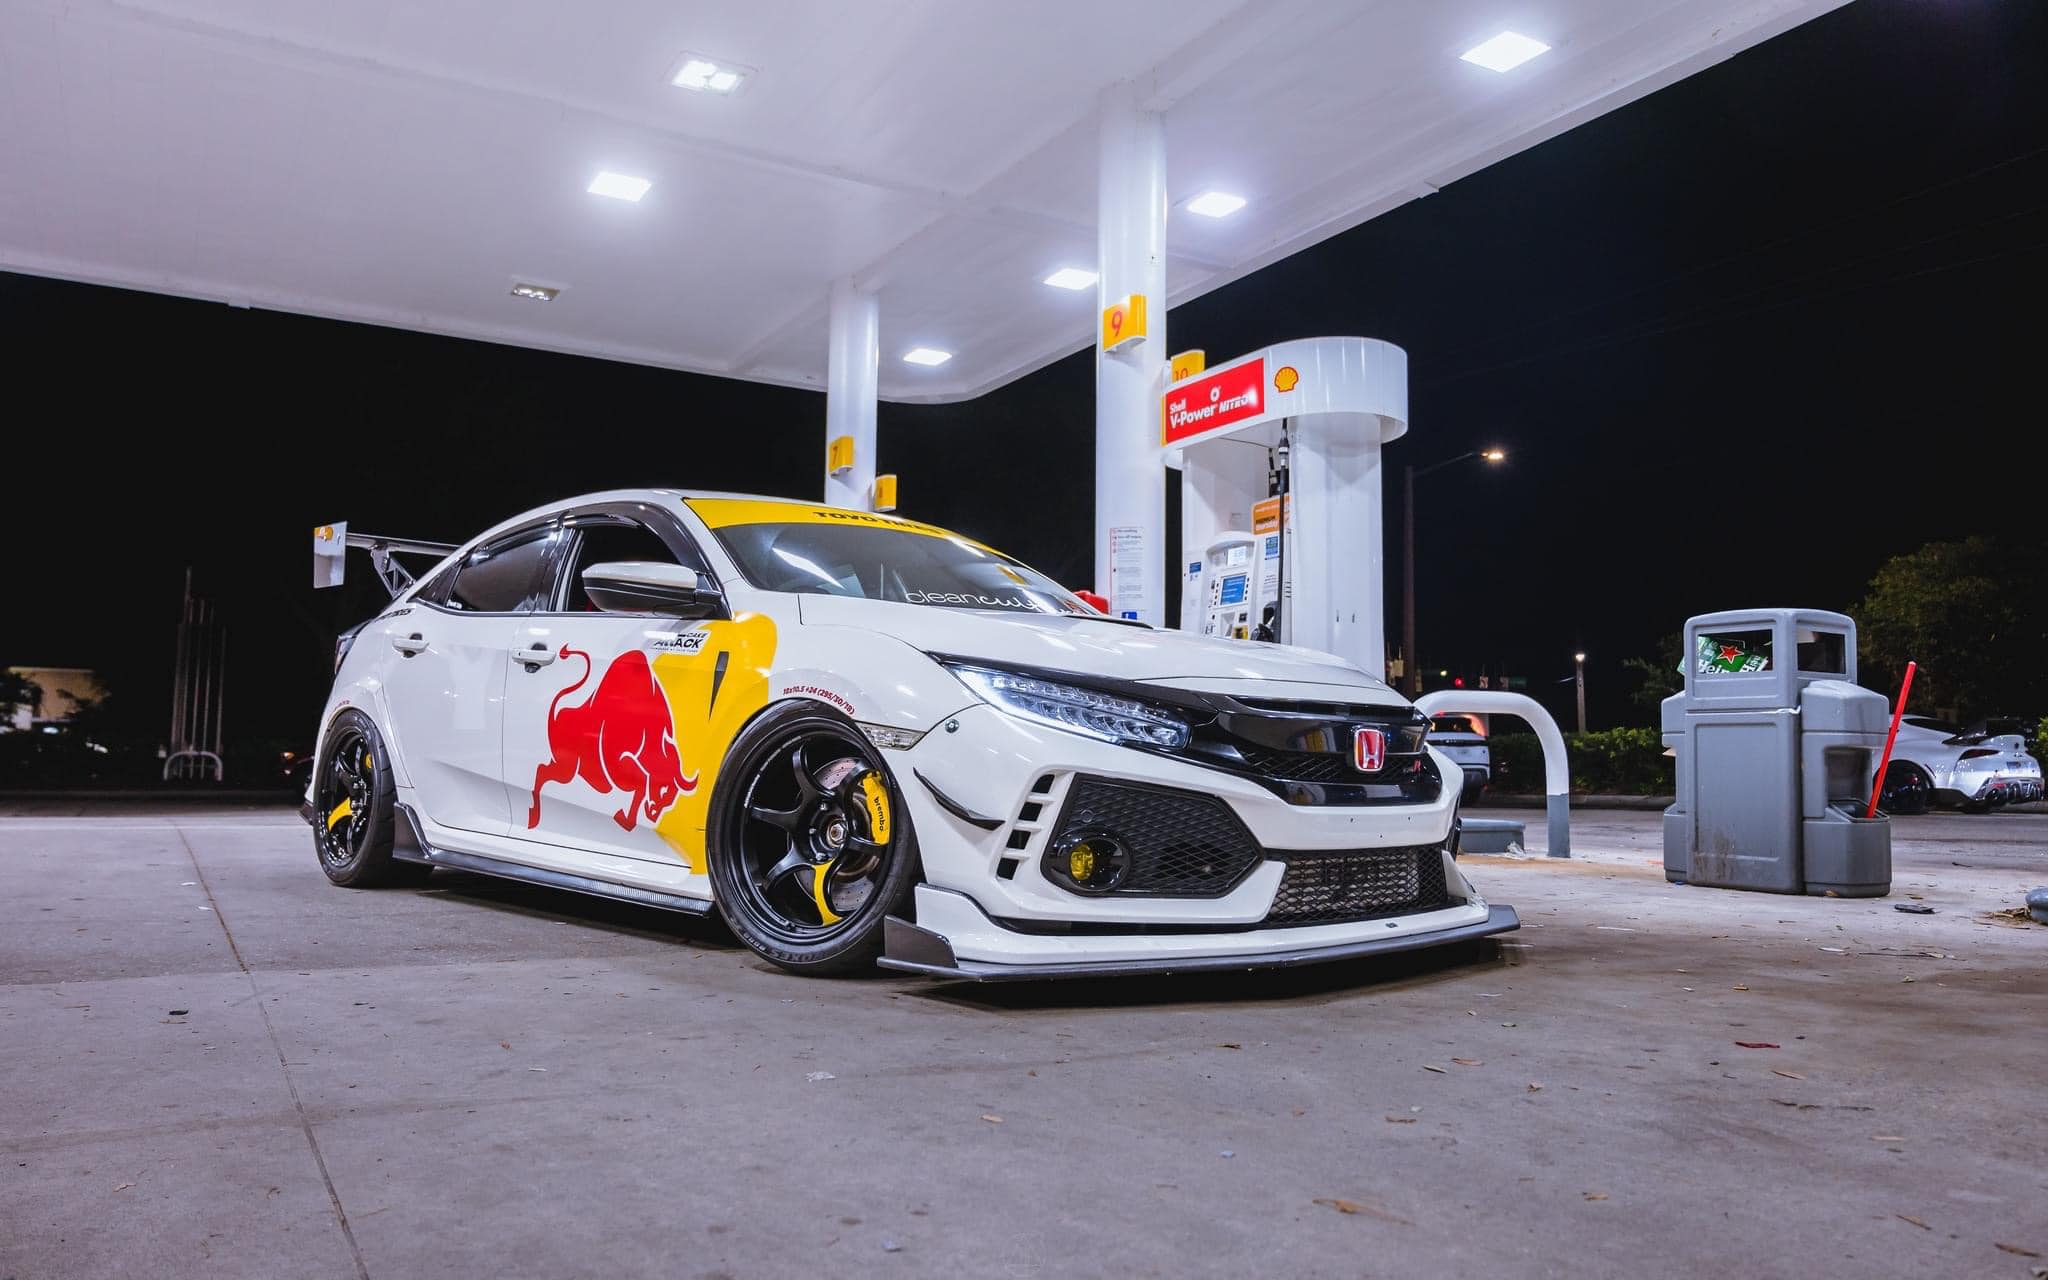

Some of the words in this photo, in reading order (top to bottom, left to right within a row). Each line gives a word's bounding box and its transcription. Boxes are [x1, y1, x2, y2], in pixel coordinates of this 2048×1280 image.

[1111, 310, 1123, 337] 9
[1169, 398, 1187, 414] Shell
[1170, 404, 1218, 429] V-Power
[813, 511, 878, 522] TOYO
[873, 796, 886, 832] brembo
